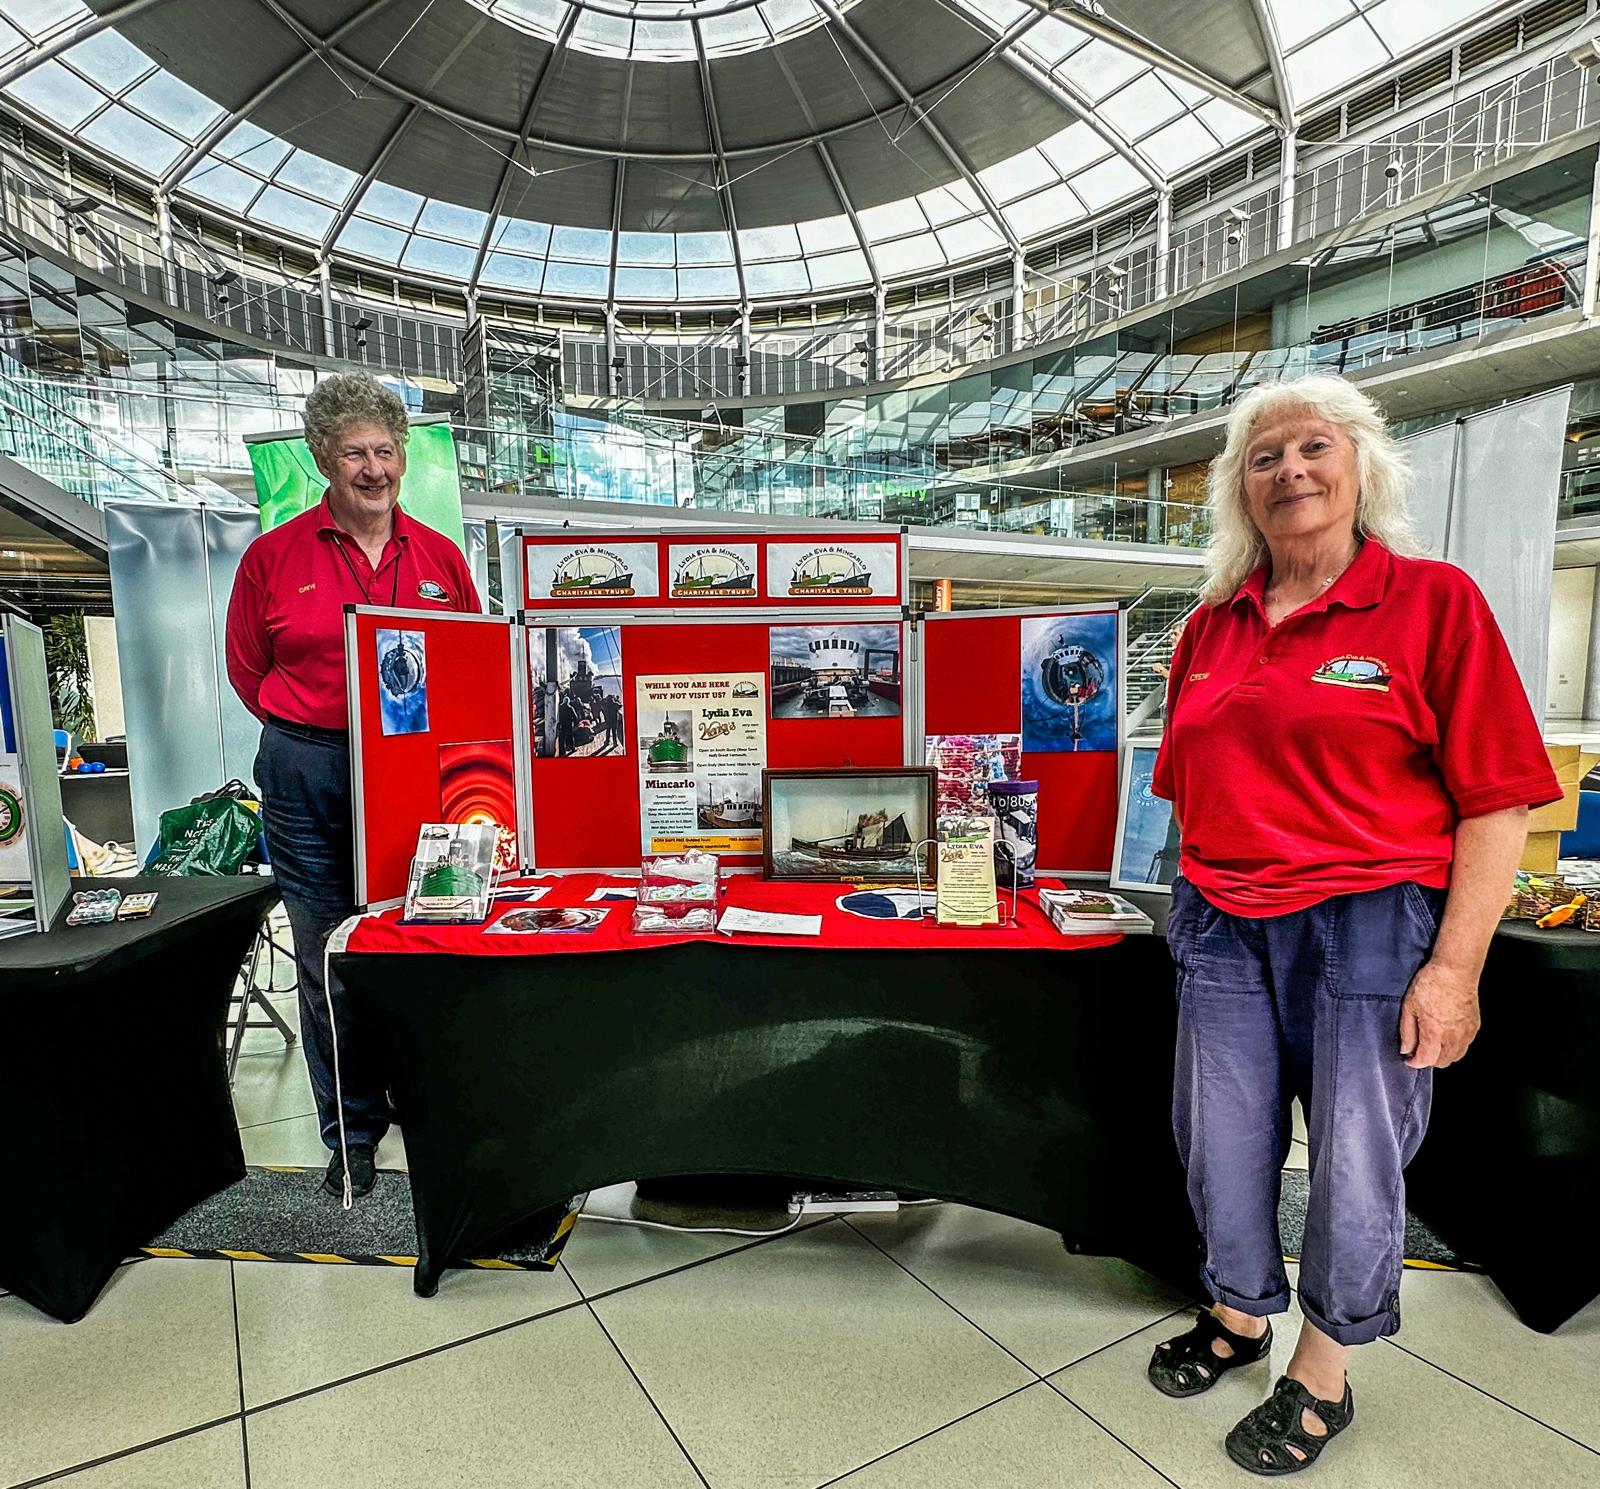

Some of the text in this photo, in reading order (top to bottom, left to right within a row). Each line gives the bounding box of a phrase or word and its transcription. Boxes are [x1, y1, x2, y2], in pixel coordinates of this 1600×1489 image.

[871, 480, 927, 501] Library
[557, 553, 575, 569] LYDIA
[574, 548, 589, 556] EVA
[597, 547, 629, 571] MINCARLO
[678, 553, 696, 569] LYDIA
[696, 548, 711, 556] EVA
[718, 547, 750, 571] MINCARLO
[796, 552, 814, 567] LYDIA
[813, 547, 828, 555] EVA
[836, 546, 867, 571] MINCARLO
[935, 585, 943, 611] Library
[1189, 672, 1211, 682] CREW
[702, 708, 753, 720] Lydia Eva
[645, 779, 695, 789] Mincarlo
